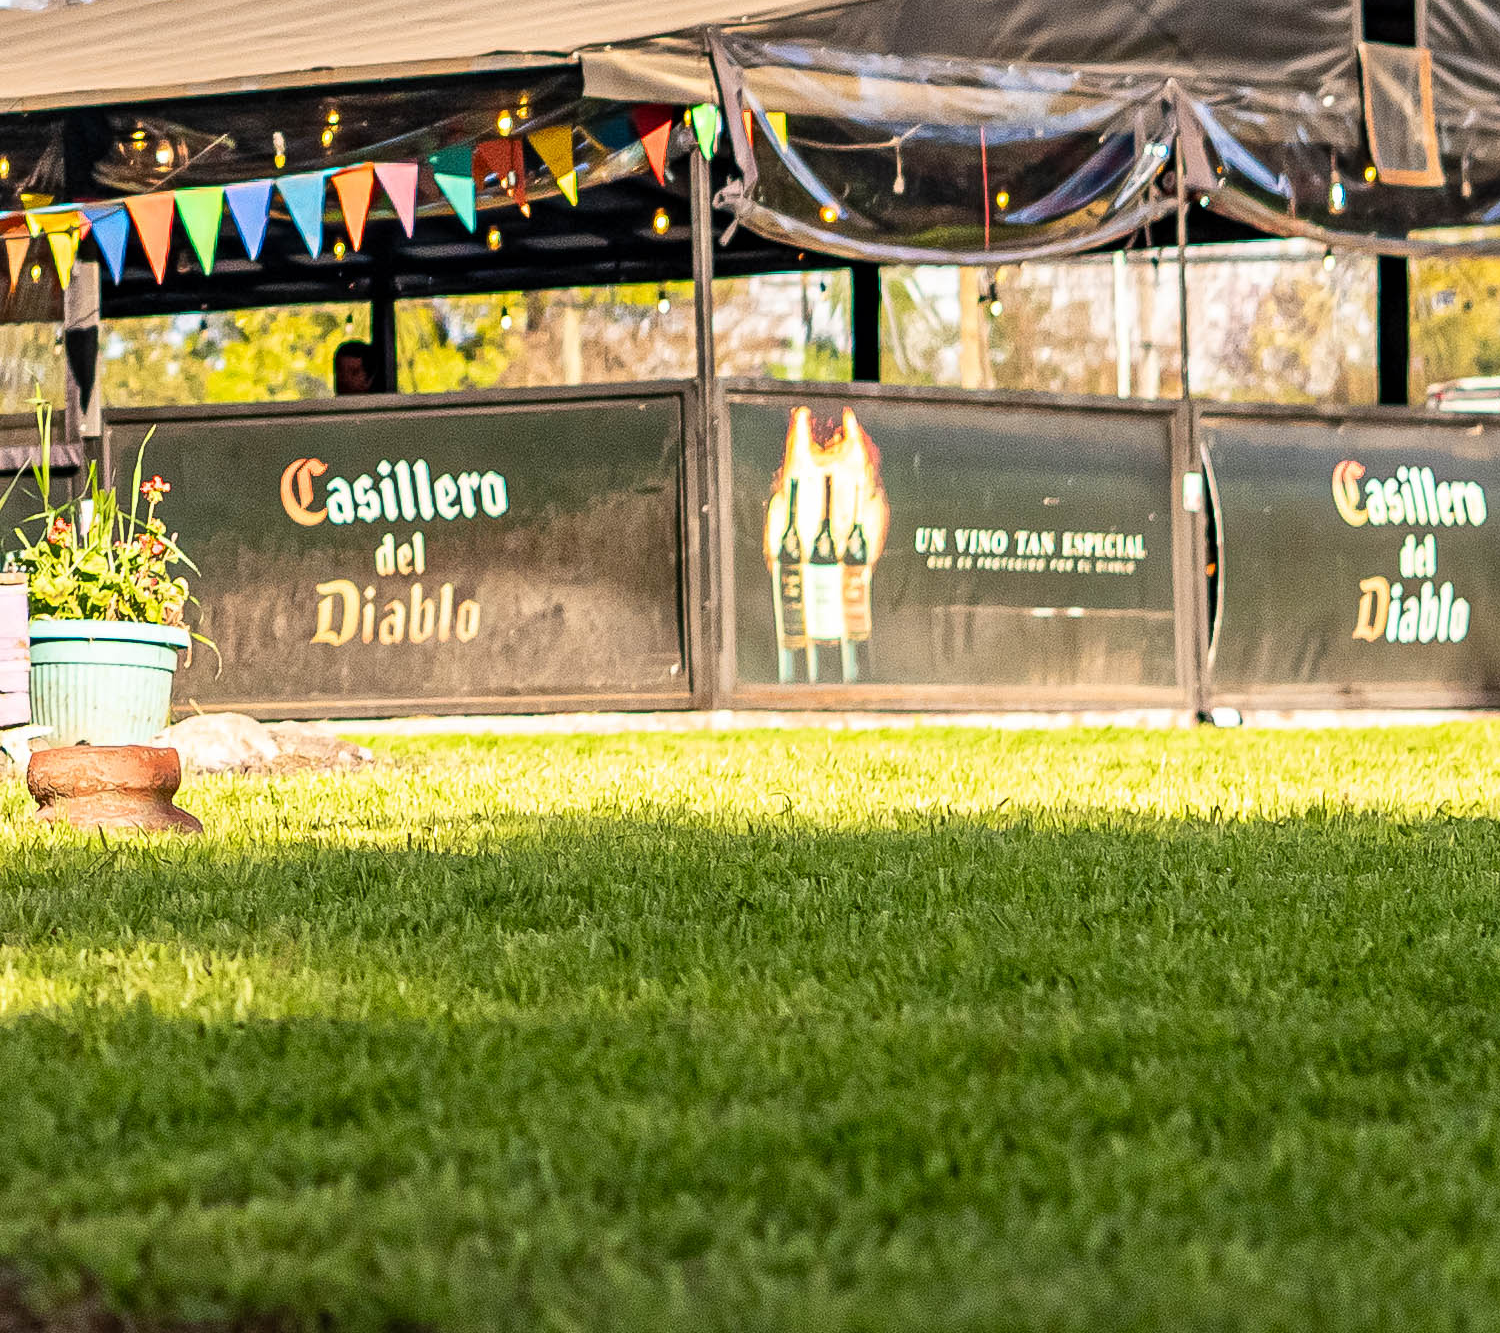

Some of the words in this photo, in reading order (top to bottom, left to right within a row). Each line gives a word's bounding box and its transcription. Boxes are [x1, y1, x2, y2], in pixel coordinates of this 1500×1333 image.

[280, 458, 509, 526] Casillero
[1332, 460, 1488, 527] Casillero
[374, 531, 426, 576] del
[915, 528, 946, 553] UN
[954, 529, 1009, 554] VINO
[1014, 530, 1056, 556] TAN
[1062, 532, 1147, 559] ESPECIAL
[1400, 533, 1437, 578] del
[310, 579, 481, 646] Diablo
[1352, 576, 1471, 644] Diablo
